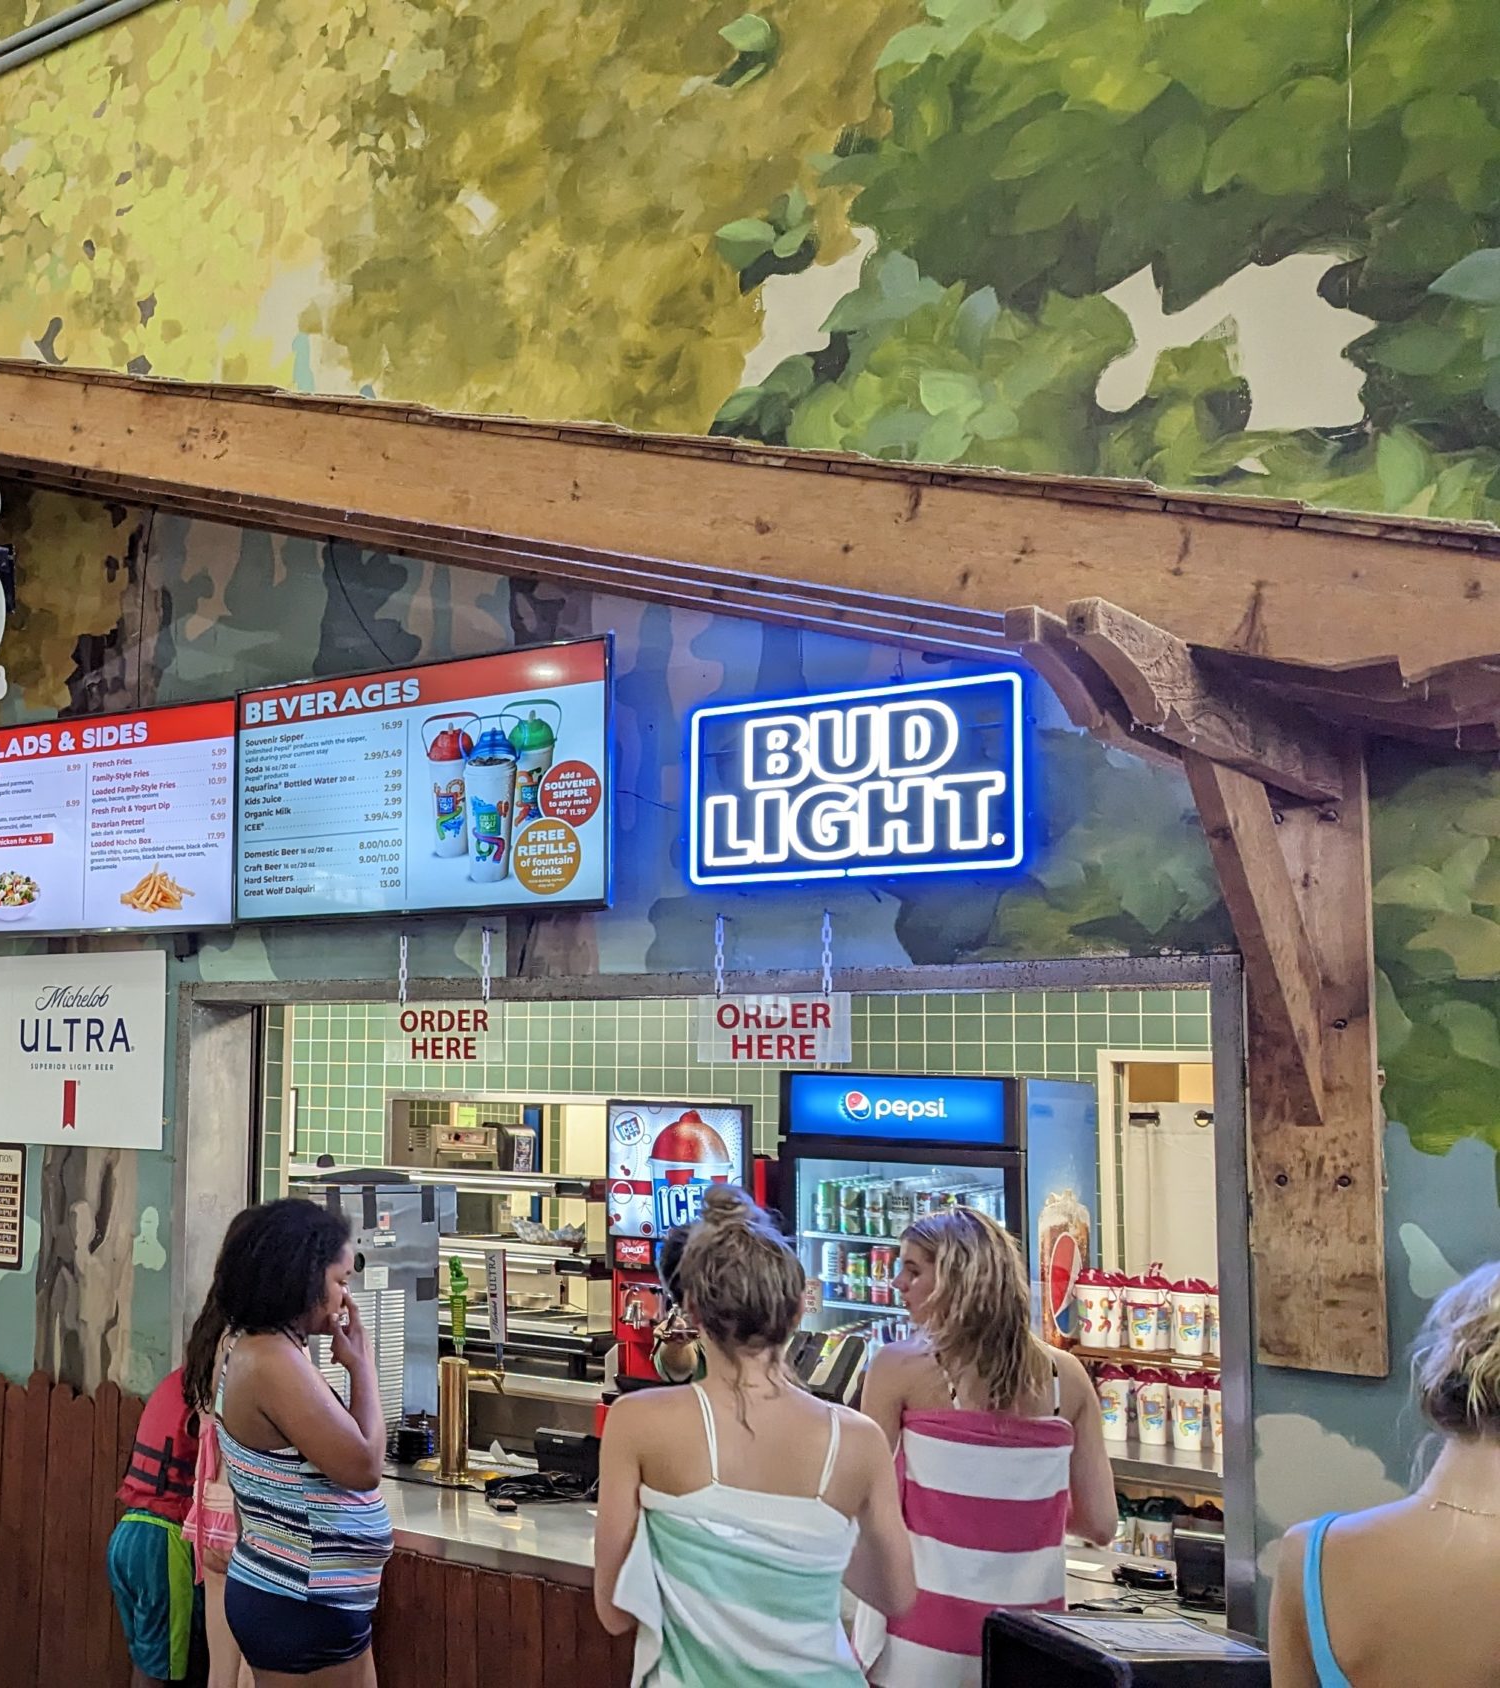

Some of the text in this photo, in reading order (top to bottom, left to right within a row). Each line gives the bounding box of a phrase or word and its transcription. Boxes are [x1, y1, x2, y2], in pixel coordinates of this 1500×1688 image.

[245, 679, 420, 724] BEVERAGES
[59, 732, 75, 750] &
[82, 722, 147, 749] SIDES
[246, 721, 402, 747] Souvenir Sipper 16.99
[212, 748, 226, 756] 5.99
[293, 742, 319, 751] products
[744, 699, 958, 790] BUD
[245, 749, 402, 774] Soda 2.99/3.49
[260, 754, 278, 762] during
[93, 762, 226, 782] Family-Style Fries 7.99
[264, 772, 289, 780] products
[284, 778, 312, 788] Bottled
[314, 776, 338, 785] Water
[385, 770, 402, 778] 2.99
[92, 787, 115, 795] Loaded
[117, 784, 157, 794] Family-Style
[160, 781, 175, 789] Fries
[544, 779, 596, 790] SOUVENIR
[245, 783, 401, 805] Kids Juice 2.99
[553, 789, 587, 798] SIPPER
[92, 807, 109, 815] Fresh
[111, 805, 126, 813] Fruit
[135, 803, 156, 812] Yogurt
[159, 802, 170, 811] Dip
[245, 809, 273, 820] Organic
[384, 798, 402, 806] 2.99
[364, 811, 402, 822] 3.99/4.99
[92, 820, 119, 828] Bavarian
[121, 818, 144, 826] Pretzel
[91, 839, 114, 847] Loaded
[116, 838, 137, 846] Nacho
[528, 829, 566, 841] FREE
[245, 849, 279, 858] Domestic
[282, 848, 298, 856] Beer
[359, 839, 402, 850] 8.00/10.00
[518, 843, 576, 856] REFILLS
[359, 853, 399, 864] 9.00/11.00
[533, 856, 573, 866] fountain
[244, 867, 398, 884] Hard Seltzers 7.00
[532, 867, 562, 876] drinks
[266, 887, 283, 895] Wolf
[286, 884, 315, 894] Daiquiri
[380, 880, 400, 888] 13.00
[35, 985, 113, 1011] Michelob
[400, 1009, 488, 1032] ORDER
[716, 1003, 831, 1029] ORDER
[20, 1017, 132, 1053] ULTRA
[411, 1037, 476, 1060] HERE
[731, 1034, 816, 1060] HERE
[657, 1185, 706, 1231] ICE
[489, 1255, 497, 1291] ULTRA
